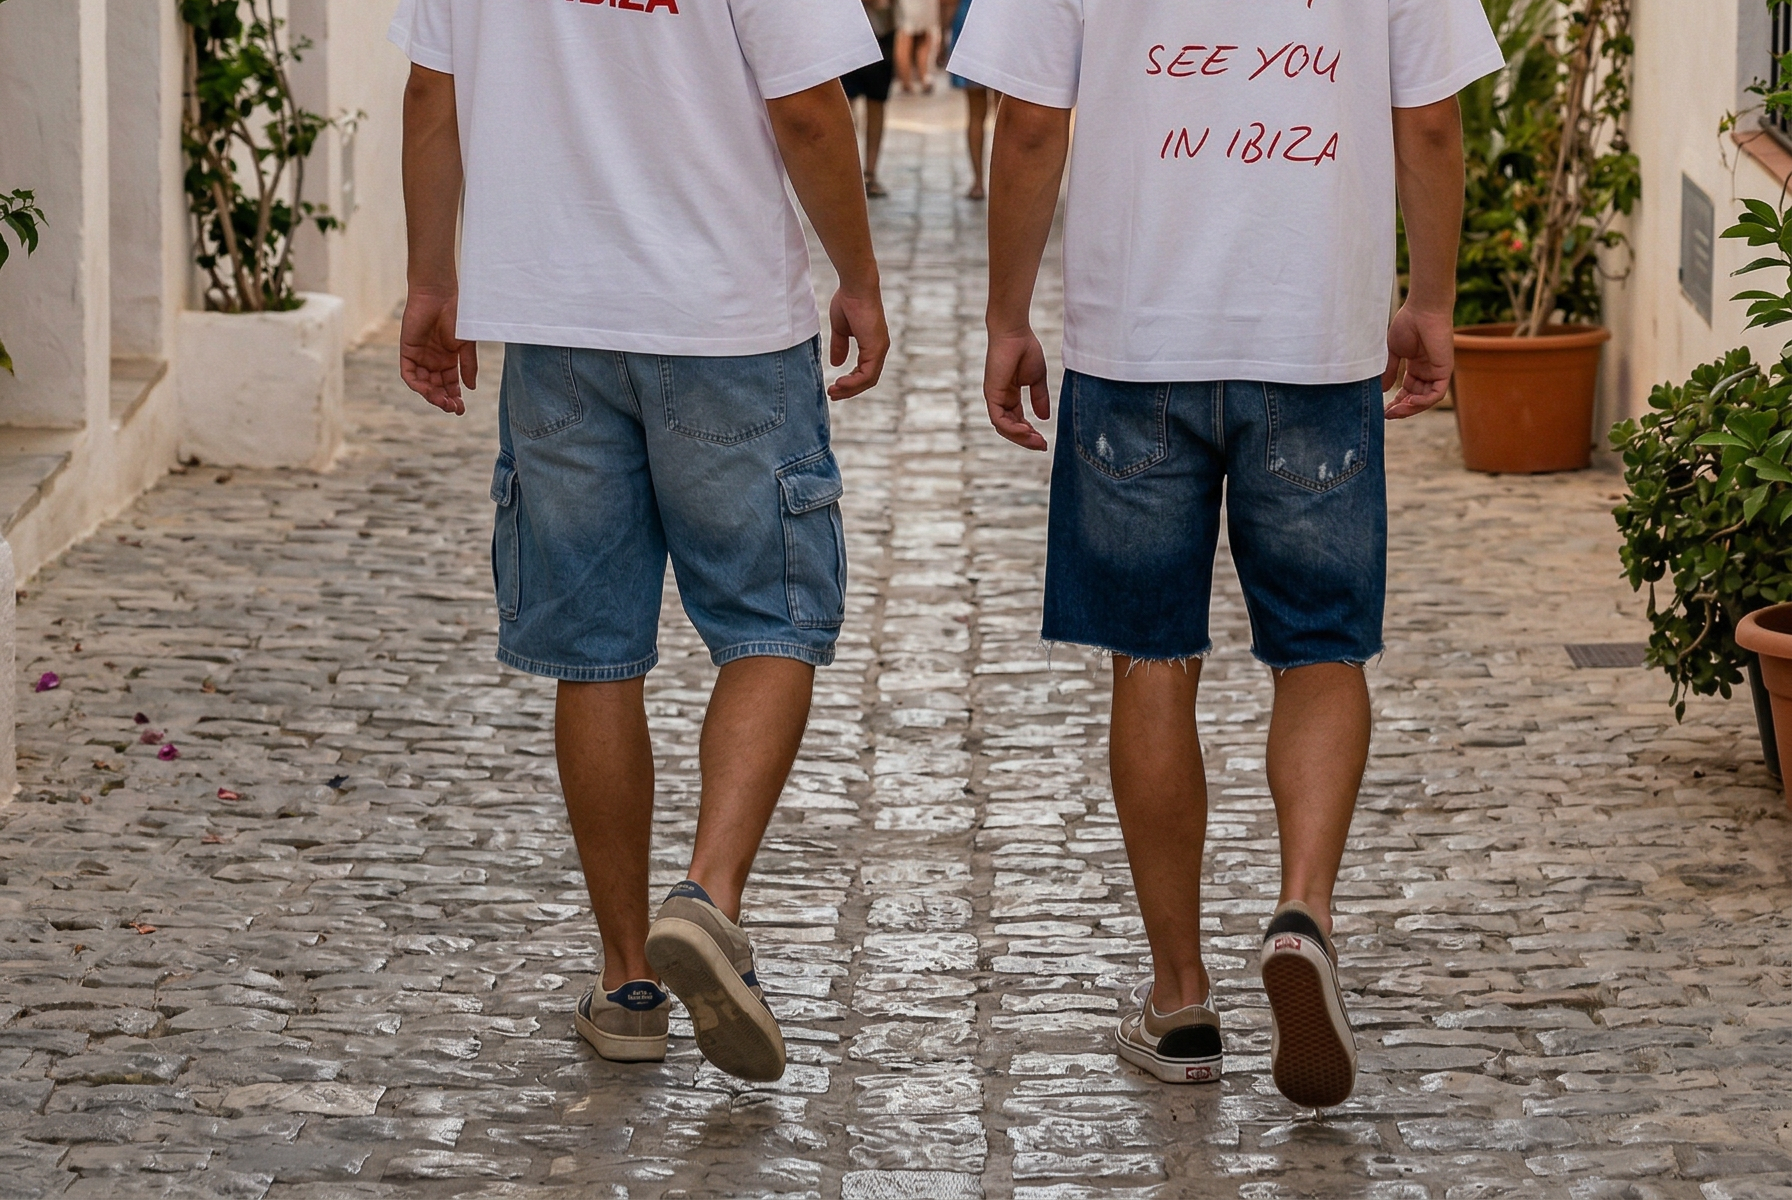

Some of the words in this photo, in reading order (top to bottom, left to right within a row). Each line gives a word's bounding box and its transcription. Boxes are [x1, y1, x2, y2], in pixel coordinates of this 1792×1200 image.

[1145, 43, 1239, 78] SEE
[1248, 40, 1341, 83] YOU
[1159, 126, 1210, 160] IN
[1225, 121, 1340, 167] IBIZA
